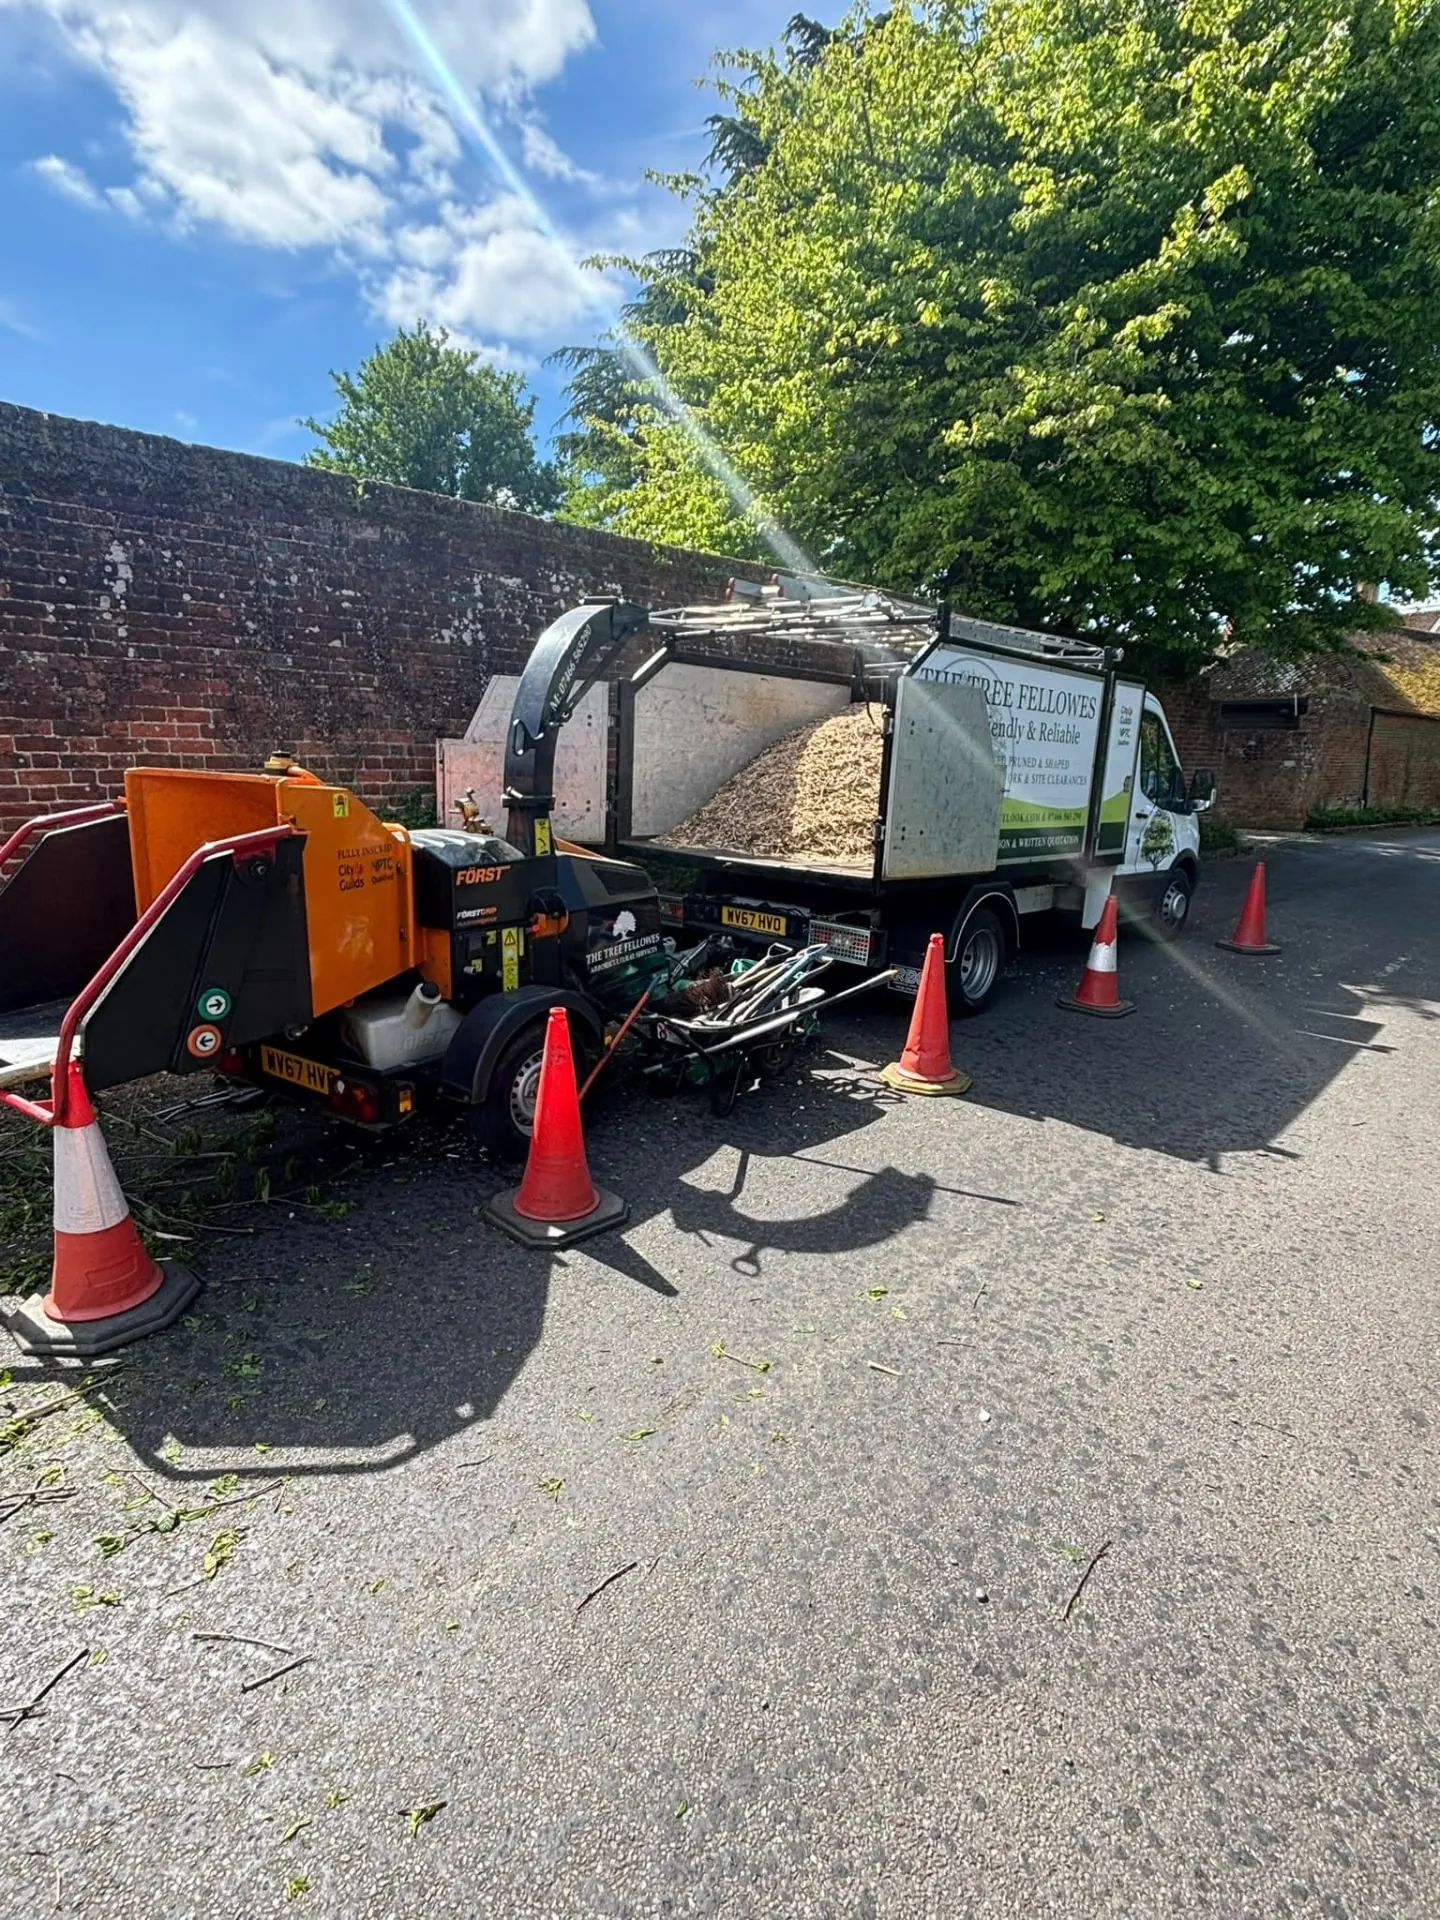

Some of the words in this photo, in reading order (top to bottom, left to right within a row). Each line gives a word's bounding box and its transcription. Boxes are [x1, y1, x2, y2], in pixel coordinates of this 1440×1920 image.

[1018, 683, 1097, 720] FELLOWES
[1027, 720, 1038, 741] &
[1039, 723, 1081, 745] Reliable
[1009, 756, 1037, 768] PRUNED
[1045, 759, 1070, 769] SHAPED
[1031, 773, 1045, 785] SITE
[1047, 774, 1087, 786] CLEARANCES
[1018, 836, 1046, 848] WRITTEN
[456, 865, 512, 886] FÖRST
[727, 907, 756, 927] WV67
[758, 914, 781, 932] HVO
[585, 950, 603, 965] THE
[603, 945, 623, 959] TREE
[624, 932, 660, 953] FELLOWES
[267, 1049, 303, 1081] WV67
